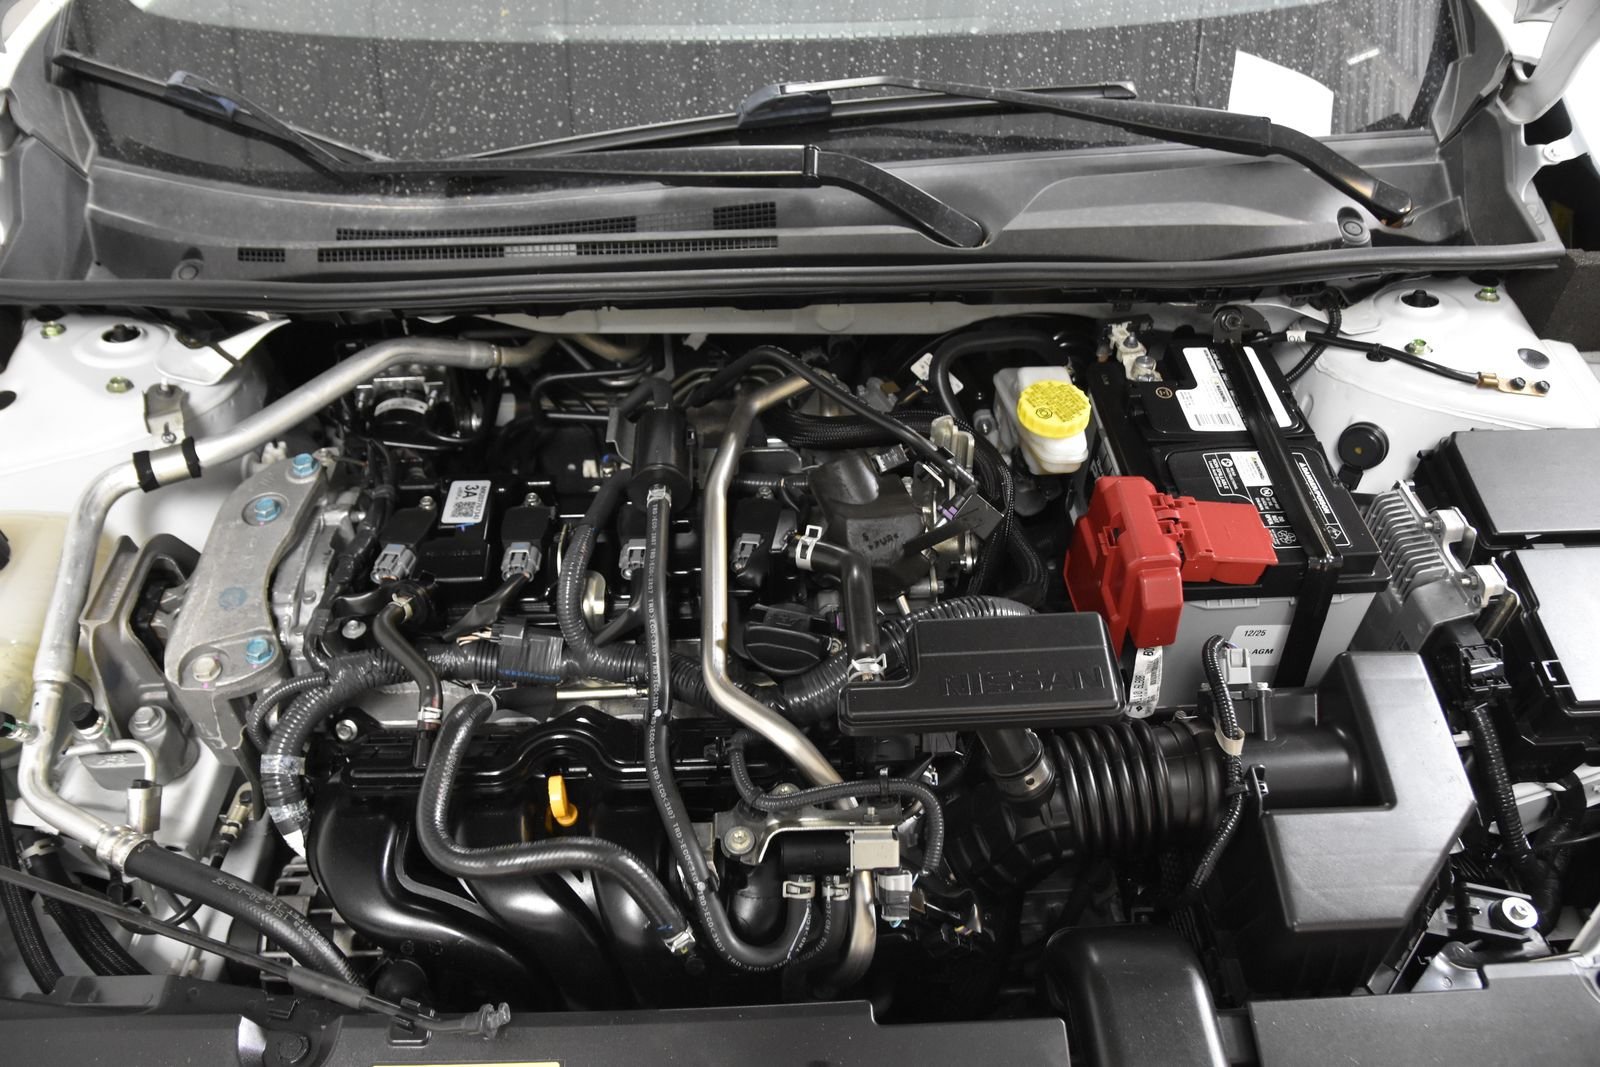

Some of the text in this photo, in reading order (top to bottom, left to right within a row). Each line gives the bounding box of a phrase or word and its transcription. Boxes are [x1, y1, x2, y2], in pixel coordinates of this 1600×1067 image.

[462, 485, 479, 498] 3A
[1244, 629, 1266, 637] 12/25
[939, 664, 1105, 696] NISSAN
